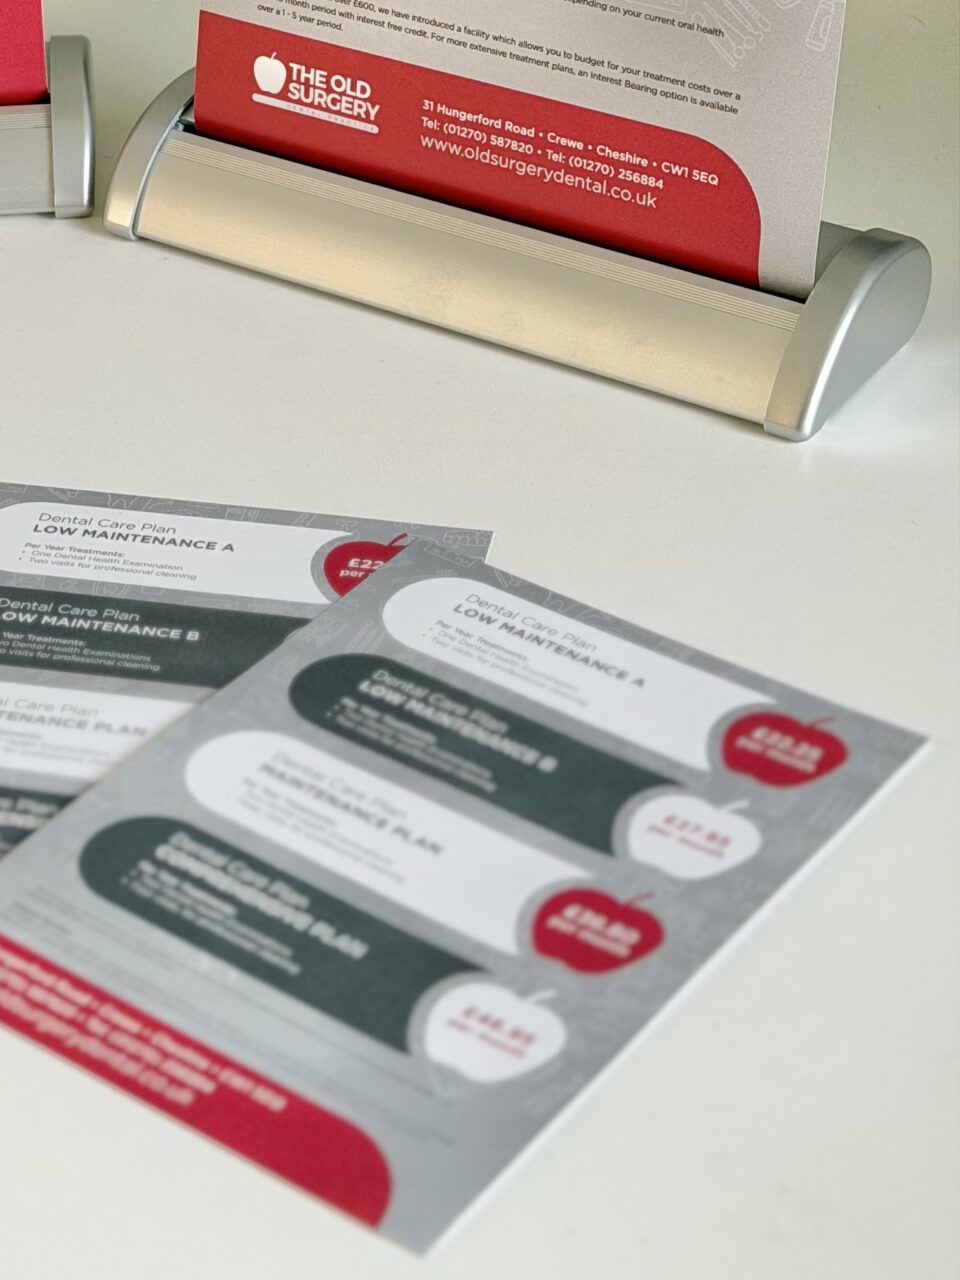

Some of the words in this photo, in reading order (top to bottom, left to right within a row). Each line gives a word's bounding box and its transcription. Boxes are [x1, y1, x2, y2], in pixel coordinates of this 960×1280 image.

[289, 62, 327, 88] THE
[330, 75, 370, 98] OLD
[288, 82, 379, 120] SURGERY
[420, 135, 656, 208] www.oldsurgerydental.co.uk
[38, 512, 93, 525] Dental
[97, 518, 135, 530] Care
[140, 523, 176, 534] Plan
[33, 524, 78, 535] LOW
[81, 529, 217, 550] MAINTENANCE
[221, 543, 234, 551] A
[54, 552, 86, 560] Dental
[88, 556, 119, 564] Health
[122, 559, 183, 570] Examination
[69, 546, 122, 557] Treatments:
[338, 569, 366, 578] per
[347, 557, 385, 570] £22
[58, 604, 97, 617] Care
[102, 608, 139, 621] Plan
[465, 593, 520, 619] Dental
[520, 616, 558, 636] Care
[561, 632, 596, 652] Plan
[41, 615, 182, 638] MAINTENANCE
[186, 630, 199, 640] B
[453, 604, 498, 624] LOW
[498, 622, 628, 679] MAINTENANCE
[93, 721, 148, 737] PLAN
